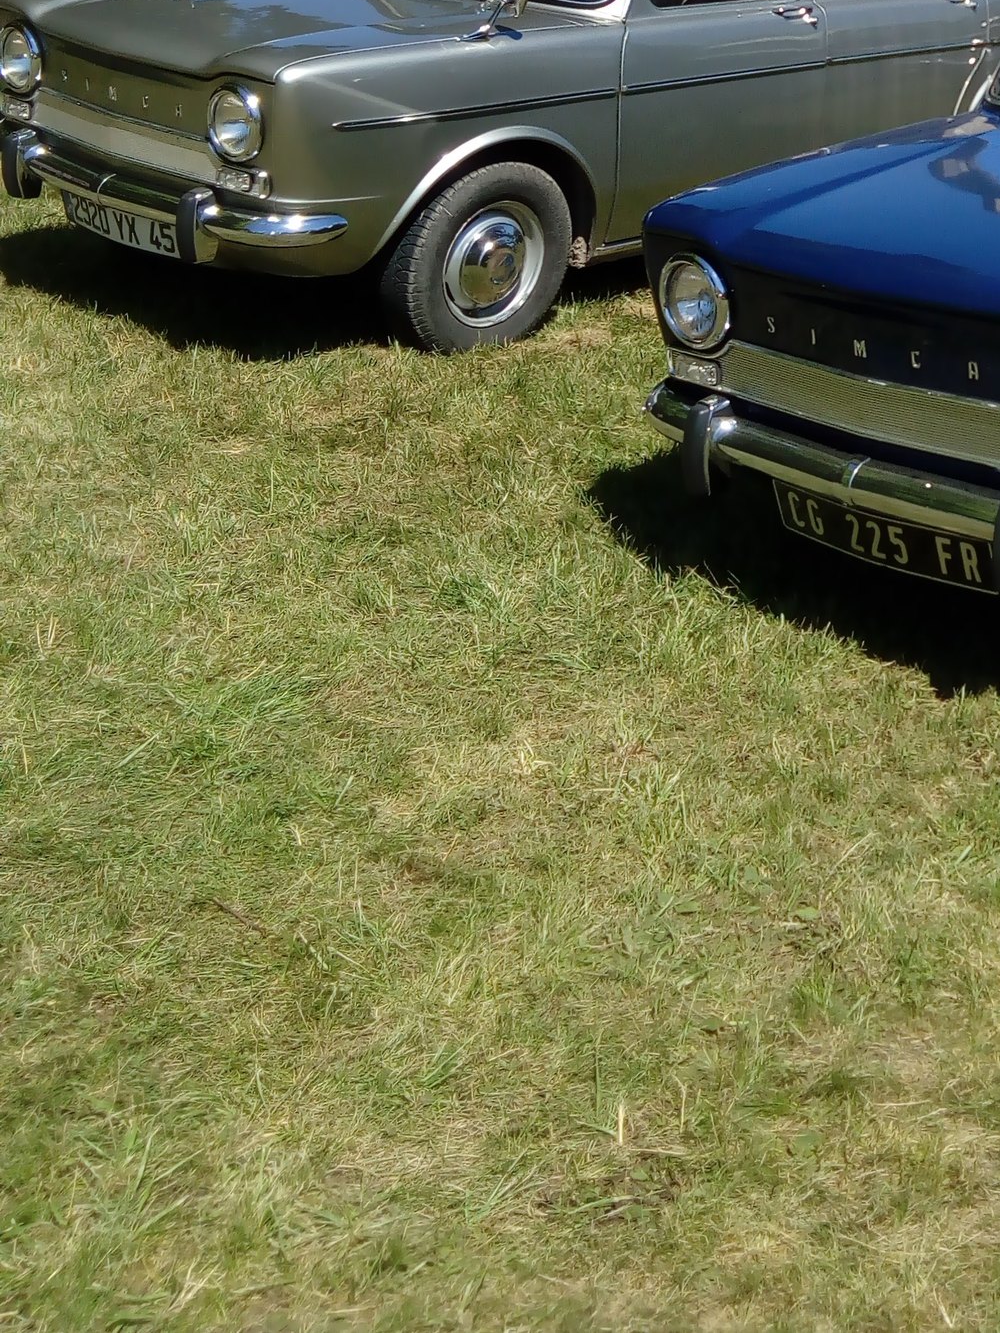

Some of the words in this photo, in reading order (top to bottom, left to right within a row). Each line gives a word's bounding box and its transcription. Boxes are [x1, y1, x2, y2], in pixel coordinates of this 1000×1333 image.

[61, 69, 183, 118] SIMCA
[72, 194, 111, 236] 2920
[113, 210, 141, 246] YX
[149, 221, 176, 254] 45
[766, 316, 980, 381] SIMCA
[787, 491, 825, 536] CG
[845, 513, 909, 565] 225
[934, 535, 982, 584] FR
